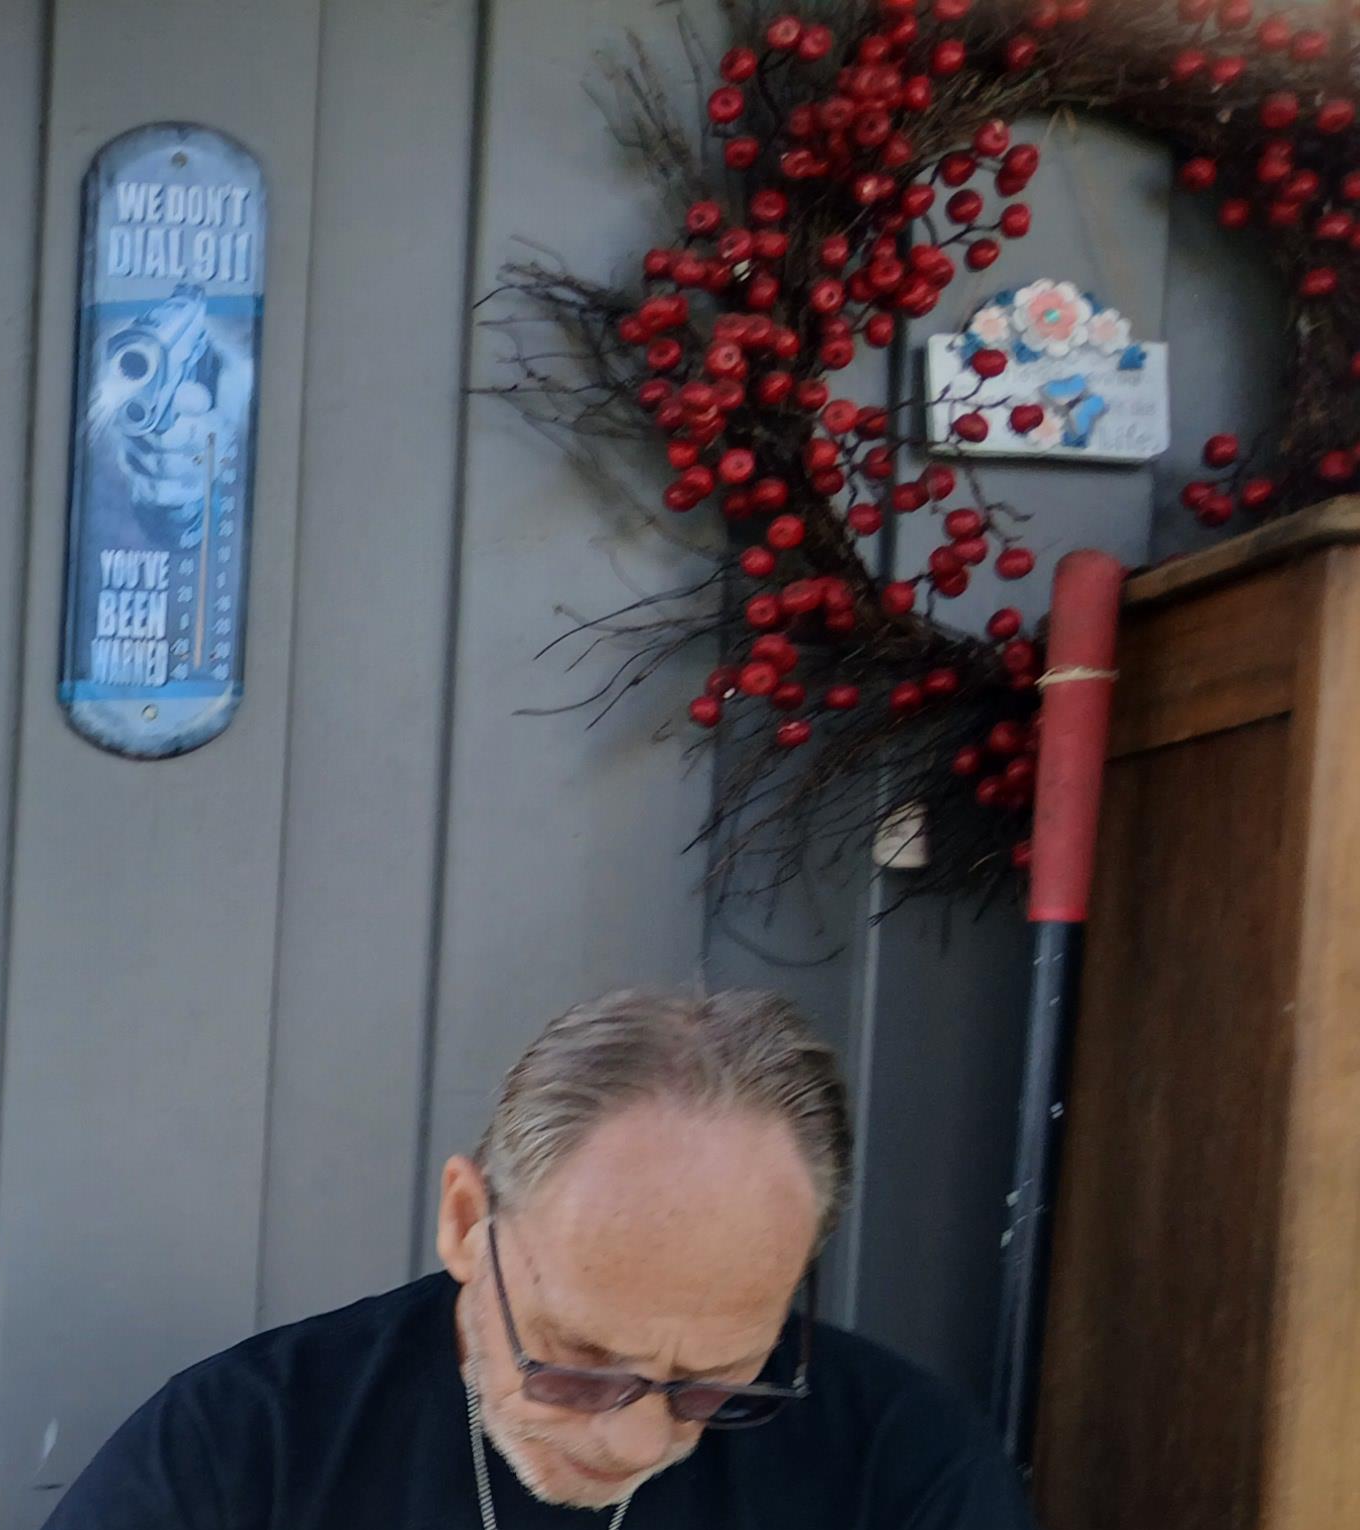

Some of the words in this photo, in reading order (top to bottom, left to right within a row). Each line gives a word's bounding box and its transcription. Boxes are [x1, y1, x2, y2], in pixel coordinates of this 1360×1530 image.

[117, 182, 164, 223] WE
[167, 185, 251, 227] DON'T
[108, 226, 186, 278] DIAL
[192, 231, 252, 281] 911
[100, 549, 169, 588] YOU'VE
[96, 590, 168, 637] BEEN
